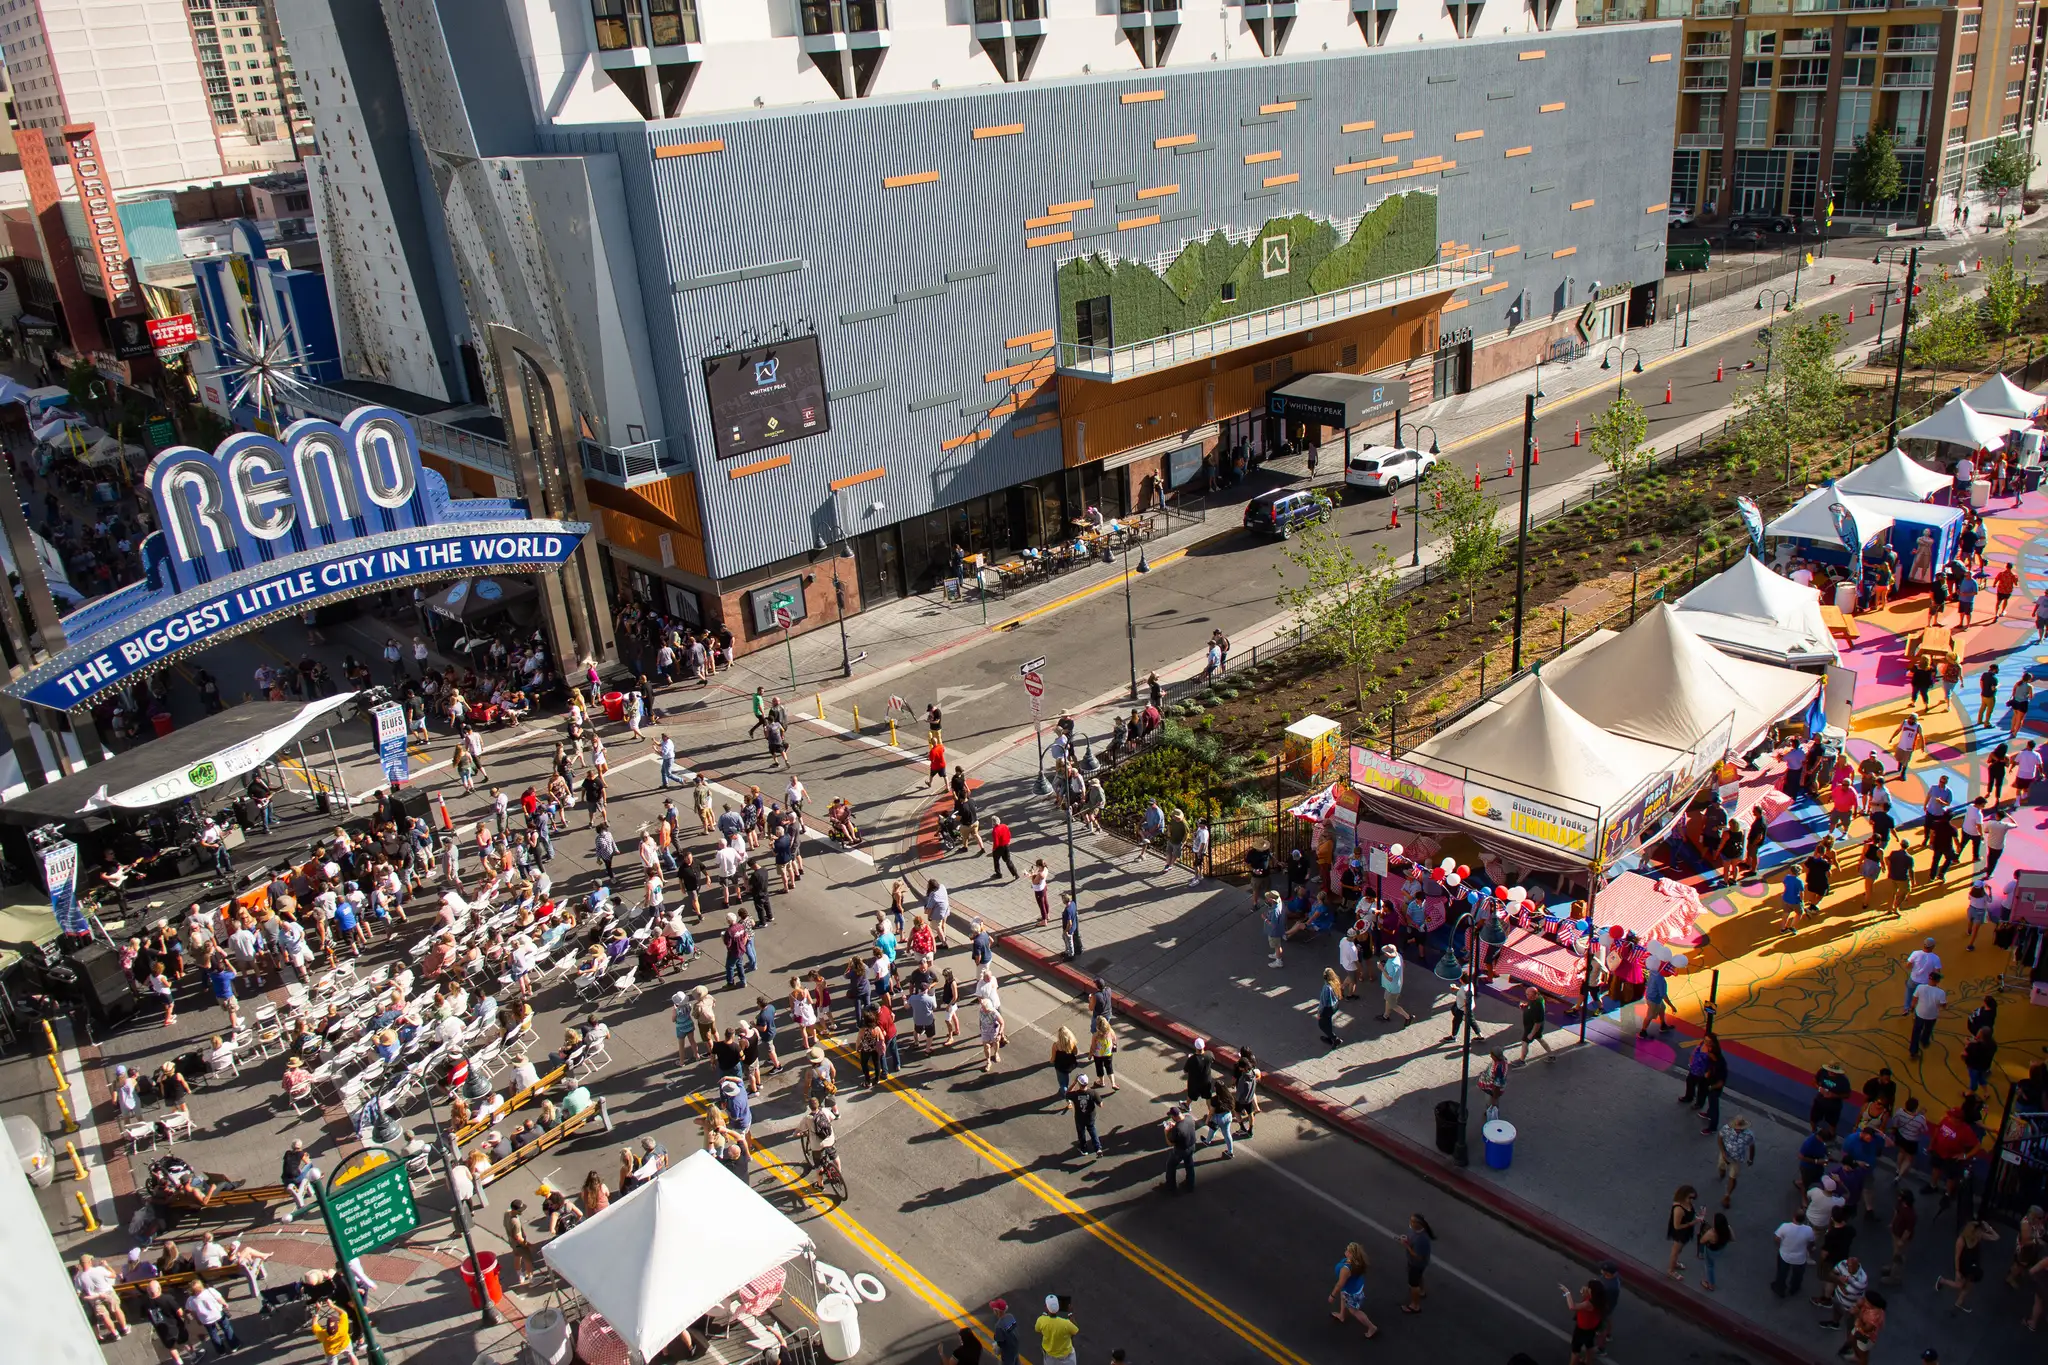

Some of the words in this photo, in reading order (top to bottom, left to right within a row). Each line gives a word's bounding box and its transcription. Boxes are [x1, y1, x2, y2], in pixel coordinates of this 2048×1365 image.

[72, 139, 137, 308] HORSESHOE
[152, 323, 194, 340] GIFTS
[1440, 325, 1473, 349] CARGO
[749, 385, 773, 396] WHITNEY
[773, 382, 787, 391] PEAK
[1288, 401, 1322, 413] WHITNEY
[1323, 407, 1342, 416] PEAK
[1361, 404, 1382, 415] WHITNEY
[1383, 399, 1394, 408] PEAK
[161, 418, 417, 562] RENO
[57, 654, 117, 697] THE
[120, 599, 232, 665] BIGGEST
[236, 572, 316, 615] LITTLE
[321, 555, 376, 586] CITY
[381, 550, 410, 574] IN
[415, 542, 462, 567] THE
[470, 537, 562, 560] WORLD
[381, 715, 403, 731] BLUES
[1358, 749, 1425, 785] Breezy
[1644, 793, 1668, 819] FRUIT
[1645, 780, 1669, 808] FRESH
[1512, 801, 1558, 824] Blueberry
[1560, 814, 1589, 833] Vodka
[1510, 810, 1588, 852] LEMONADE
[335, 1198, 355, 1211] Greater
[356, 1187, 376, 1200] Nevada
[377, 1179, 390, 1190] Field
[339, 1204, 361, 1219] Amtrak
[345, 1208, 370, 1223] Heritage
[373, 1196, 392, 1209] Center
[344, 1225, 357, 1236] City
[348, 1231, 372, 1246] Truckee
[373, 1221, 388, 1233] River
[389, 1213, 404, 1224] Walk
[351, 1239, 374, 1255] Pioneer
[377, 1228, 397, 1241] Center
